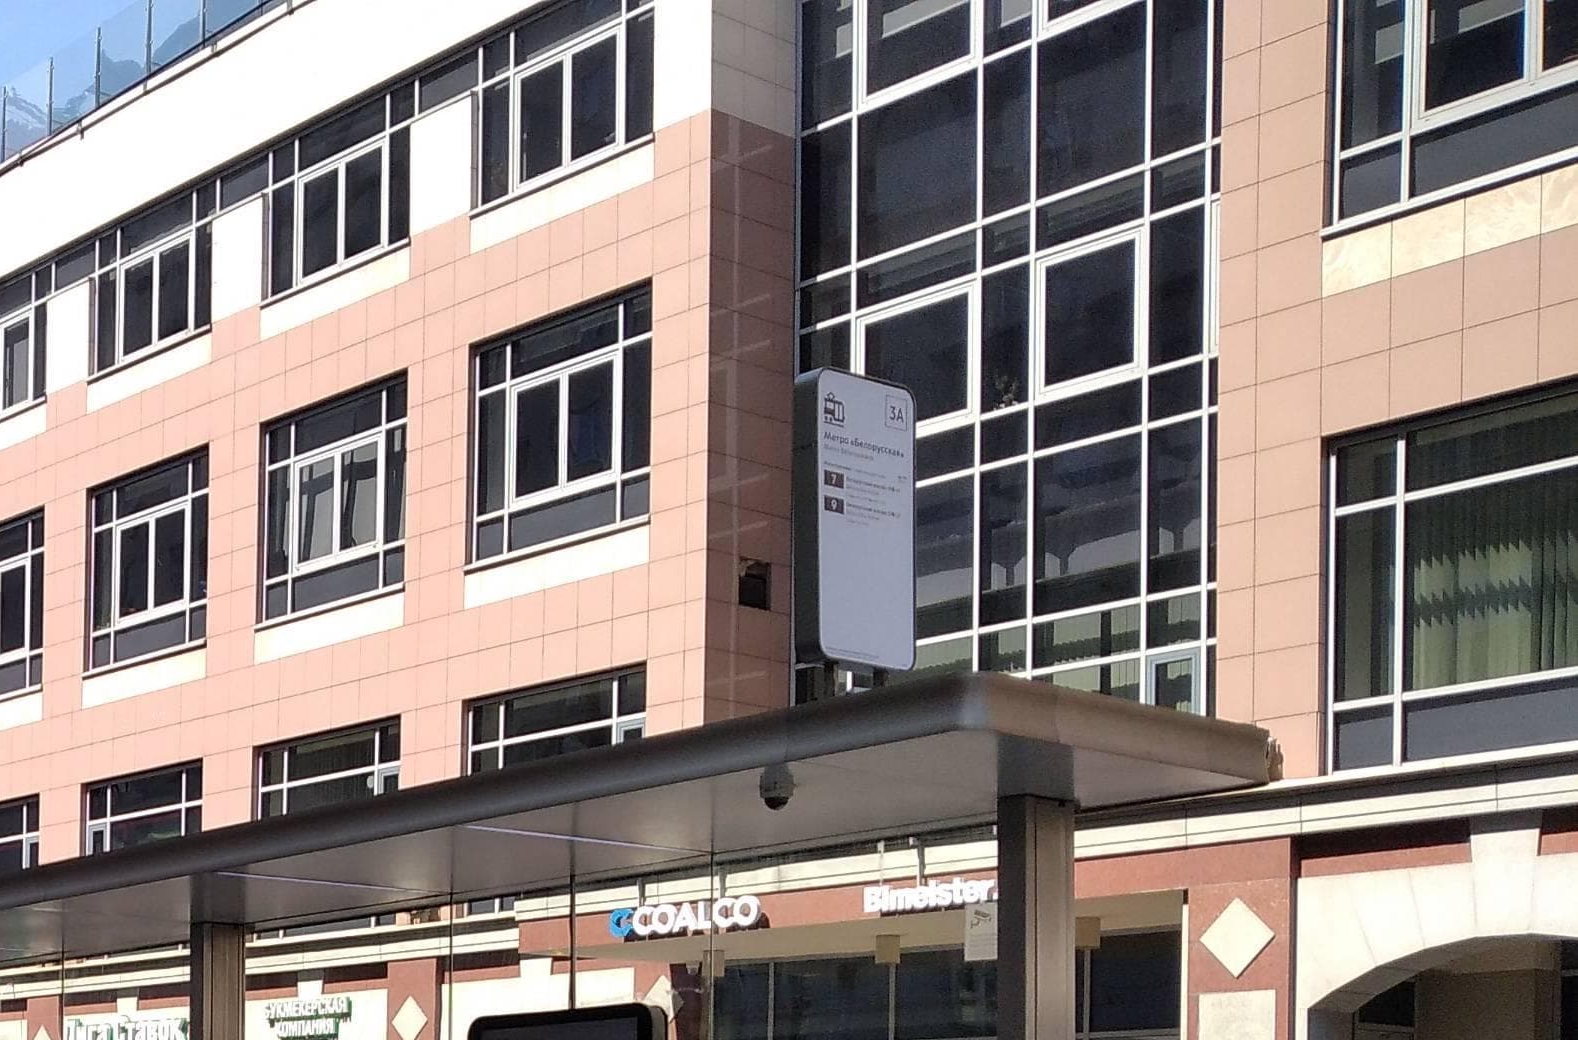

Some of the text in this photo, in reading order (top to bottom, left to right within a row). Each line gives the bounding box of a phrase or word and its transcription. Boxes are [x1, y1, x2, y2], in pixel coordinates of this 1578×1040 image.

[889, 405, 904, 423] 3А
[824, 431, 849, 445] Метро
[830, 473, 837, 485] 7
[830, 499, 838, 511] 9
[263, 997, 350, 1019] БУКМЕКЕРСКАЯ
[276, 1018, 336, 1038] КОМПАНИЯ
